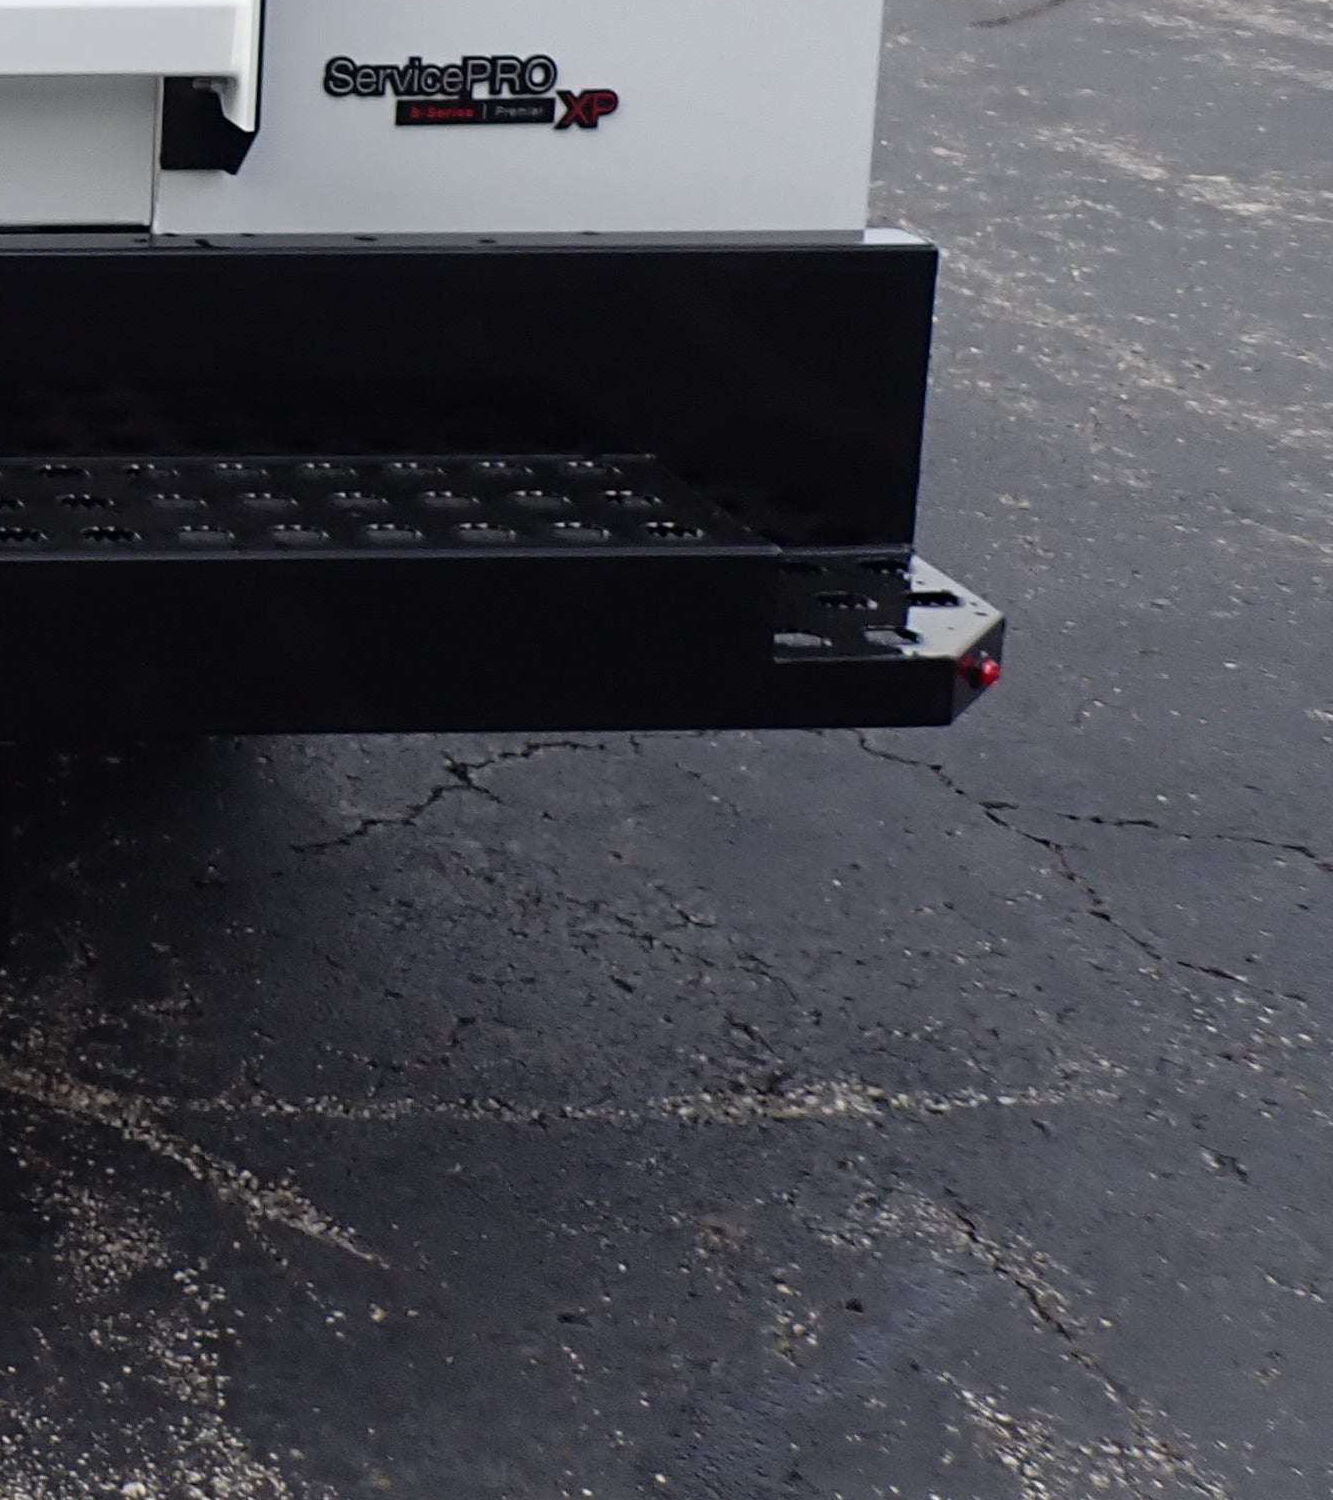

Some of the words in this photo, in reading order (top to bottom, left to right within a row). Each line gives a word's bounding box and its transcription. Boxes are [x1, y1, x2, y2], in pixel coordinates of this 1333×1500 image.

[325, 56, 557, 96] ServicePRO
[495, 105, 543, 117] Premier
[559, 91, 618, 128] XP
